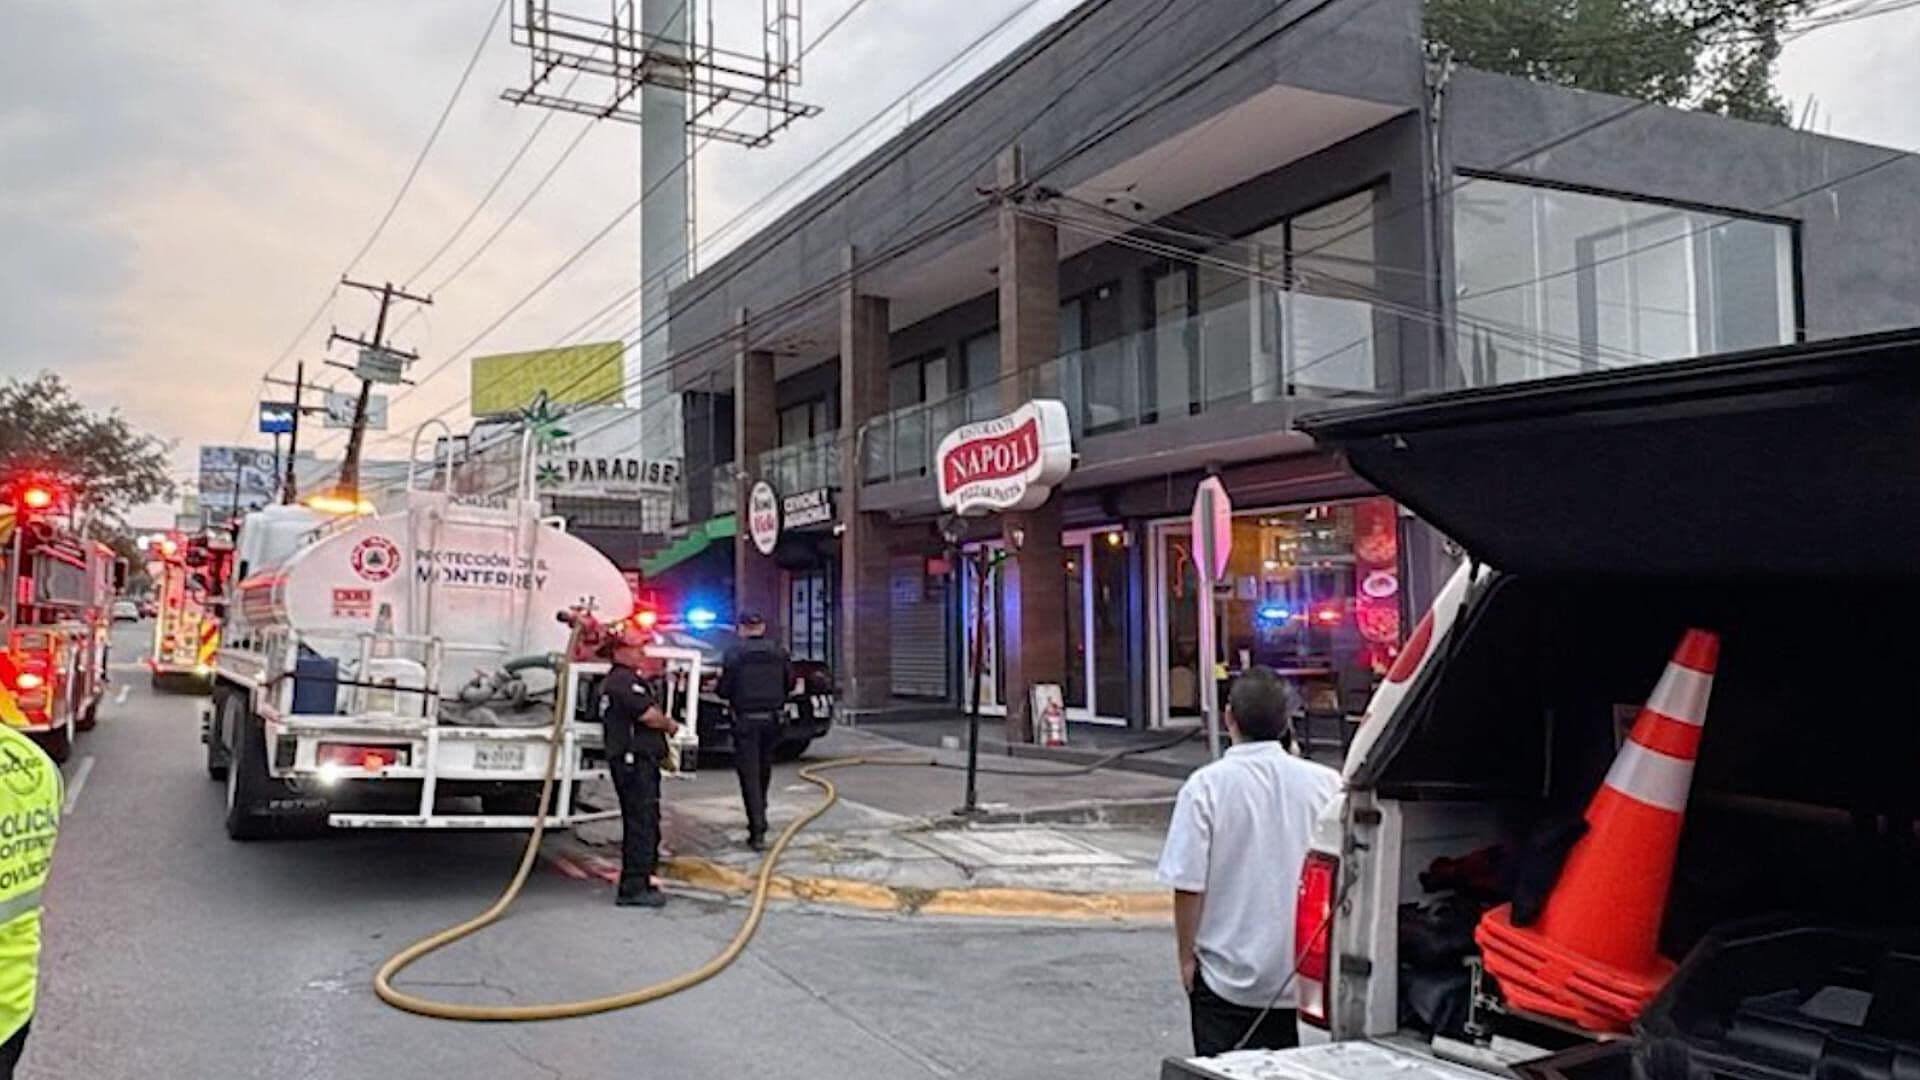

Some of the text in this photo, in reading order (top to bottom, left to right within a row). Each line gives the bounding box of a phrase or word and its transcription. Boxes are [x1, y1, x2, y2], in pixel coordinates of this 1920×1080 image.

[950, 432, 1034, 484] NAPOLI
[567, 458, 675, 484] PARADISE
[517, 556, 549, 571] CIIL
[416, 566, 548, 591] MONTERREY
